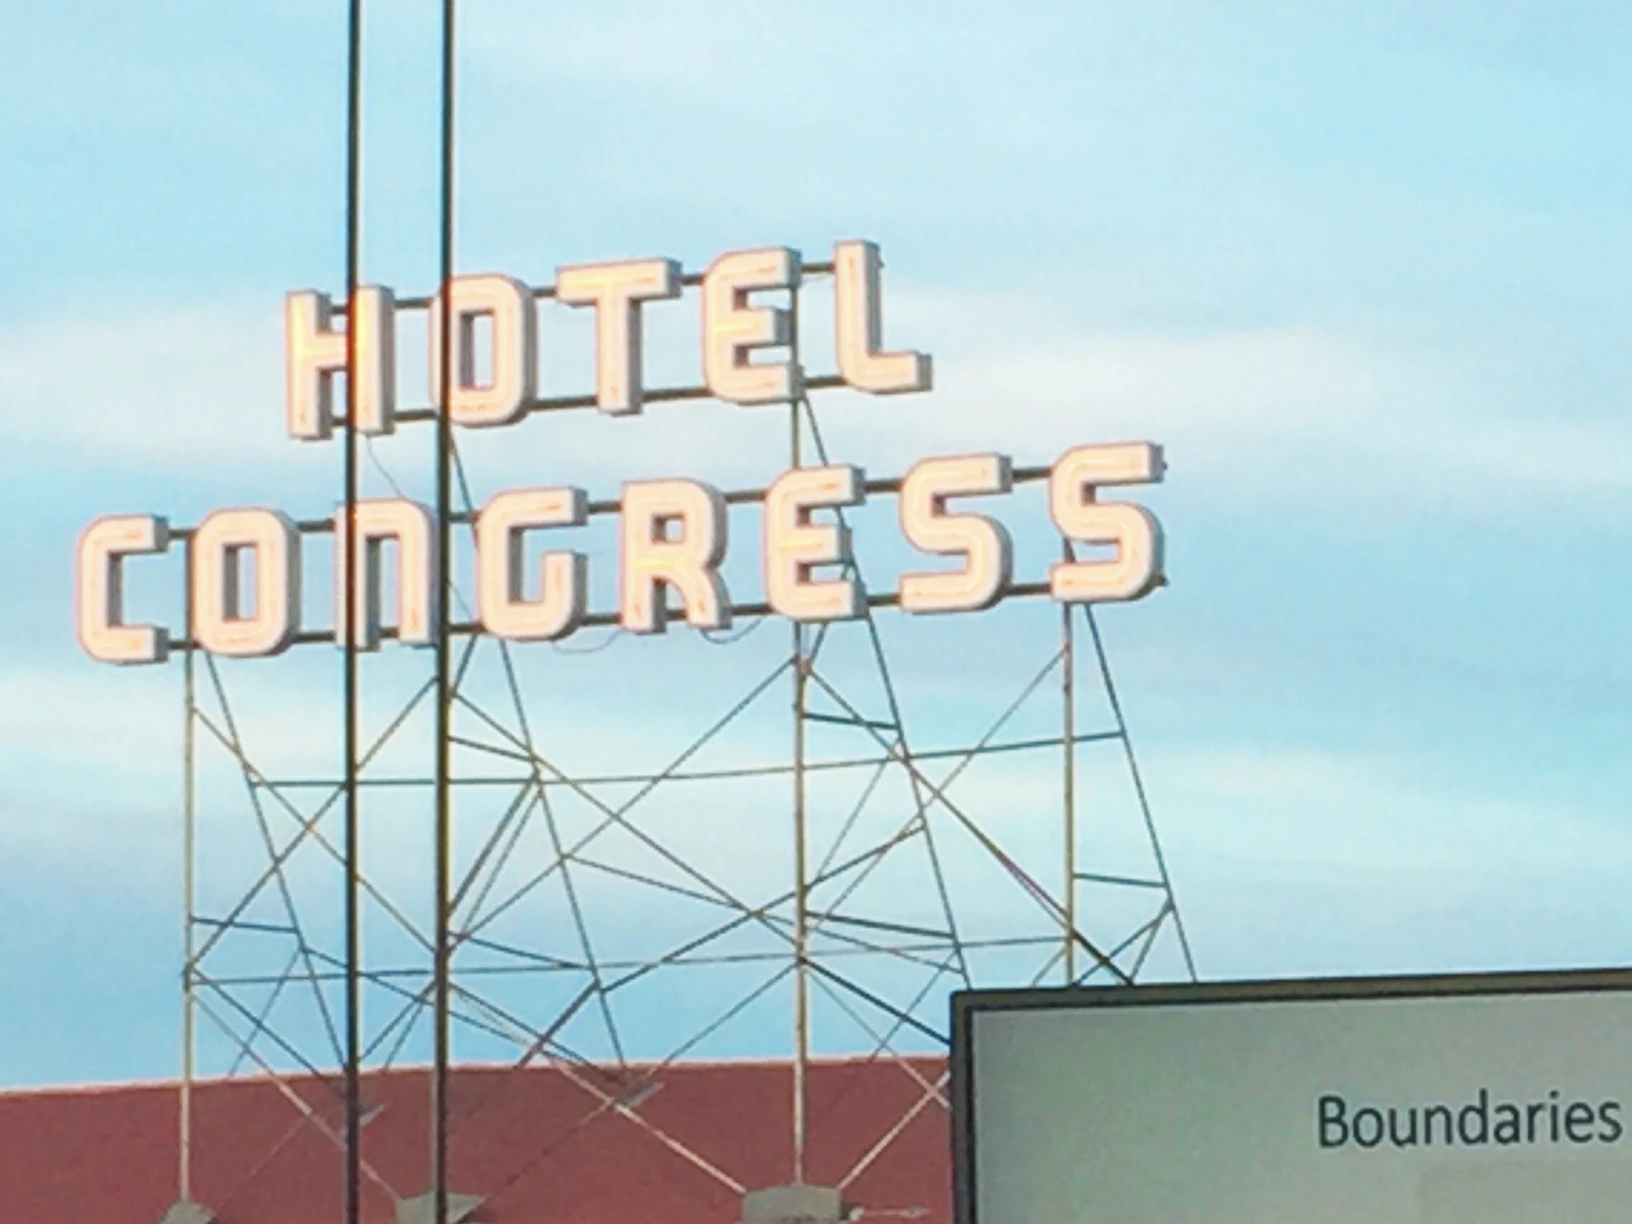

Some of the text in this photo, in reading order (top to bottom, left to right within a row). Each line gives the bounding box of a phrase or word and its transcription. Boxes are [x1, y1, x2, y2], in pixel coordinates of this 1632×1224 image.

[285, 239, 932, 439] HOTEL
[76, 441, 1165, 664] CONGRESS
[1317, 1088, 1624, 1148] Boundaries
